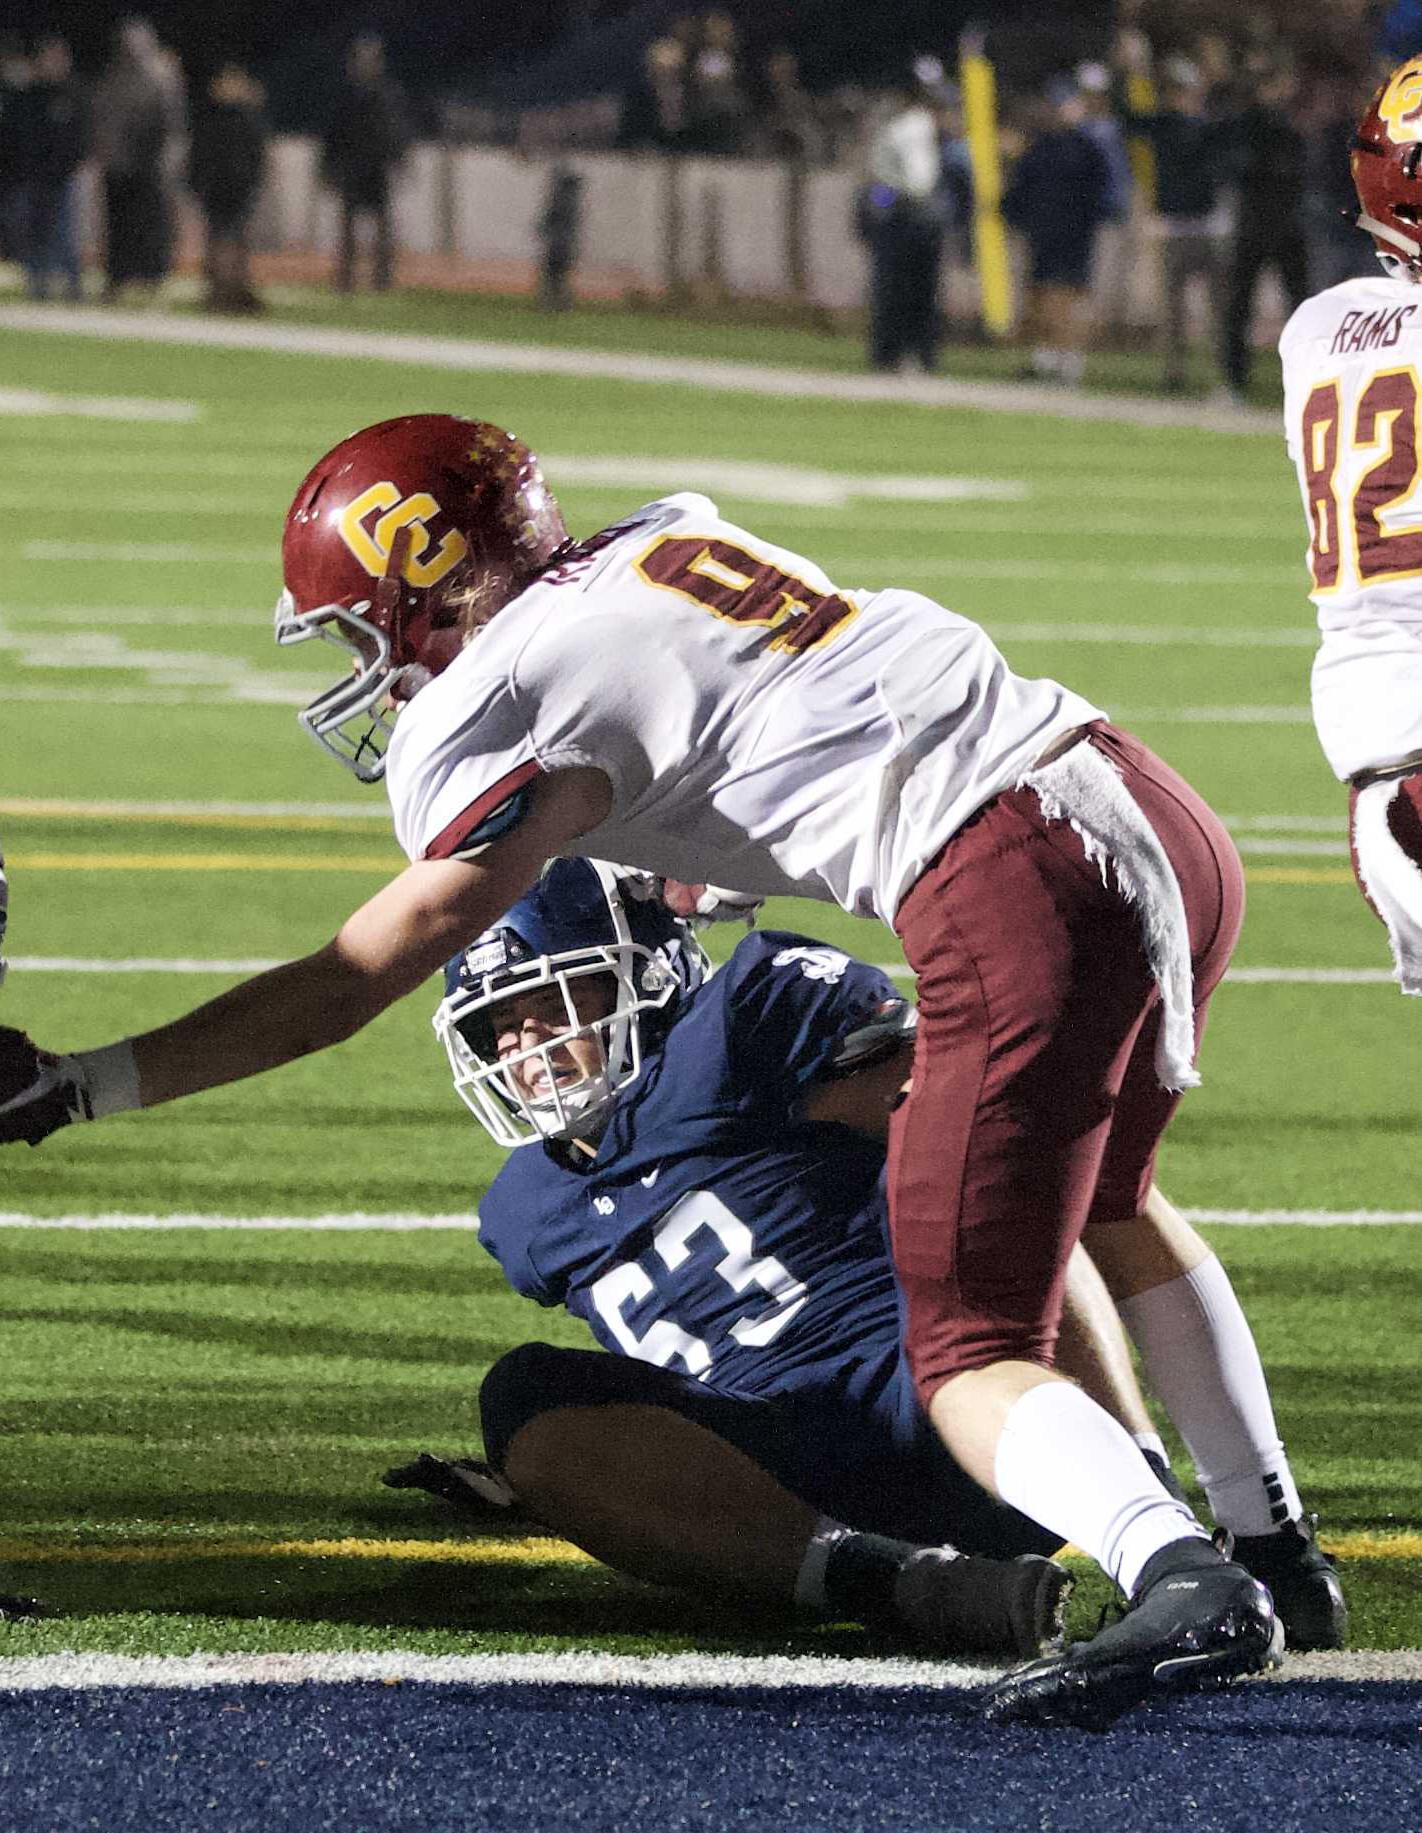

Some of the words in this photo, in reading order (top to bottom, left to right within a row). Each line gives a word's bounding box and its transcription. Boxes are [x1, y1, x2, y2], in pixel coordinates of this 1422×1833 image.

[1330, 304, 1418, 355] RAMS
[338, 481, 468, 588] CC
[1302, 364, 1422, 598] 82
[631, 534, 859, 655] 9
[591, 1190, 802, 1382] 63
